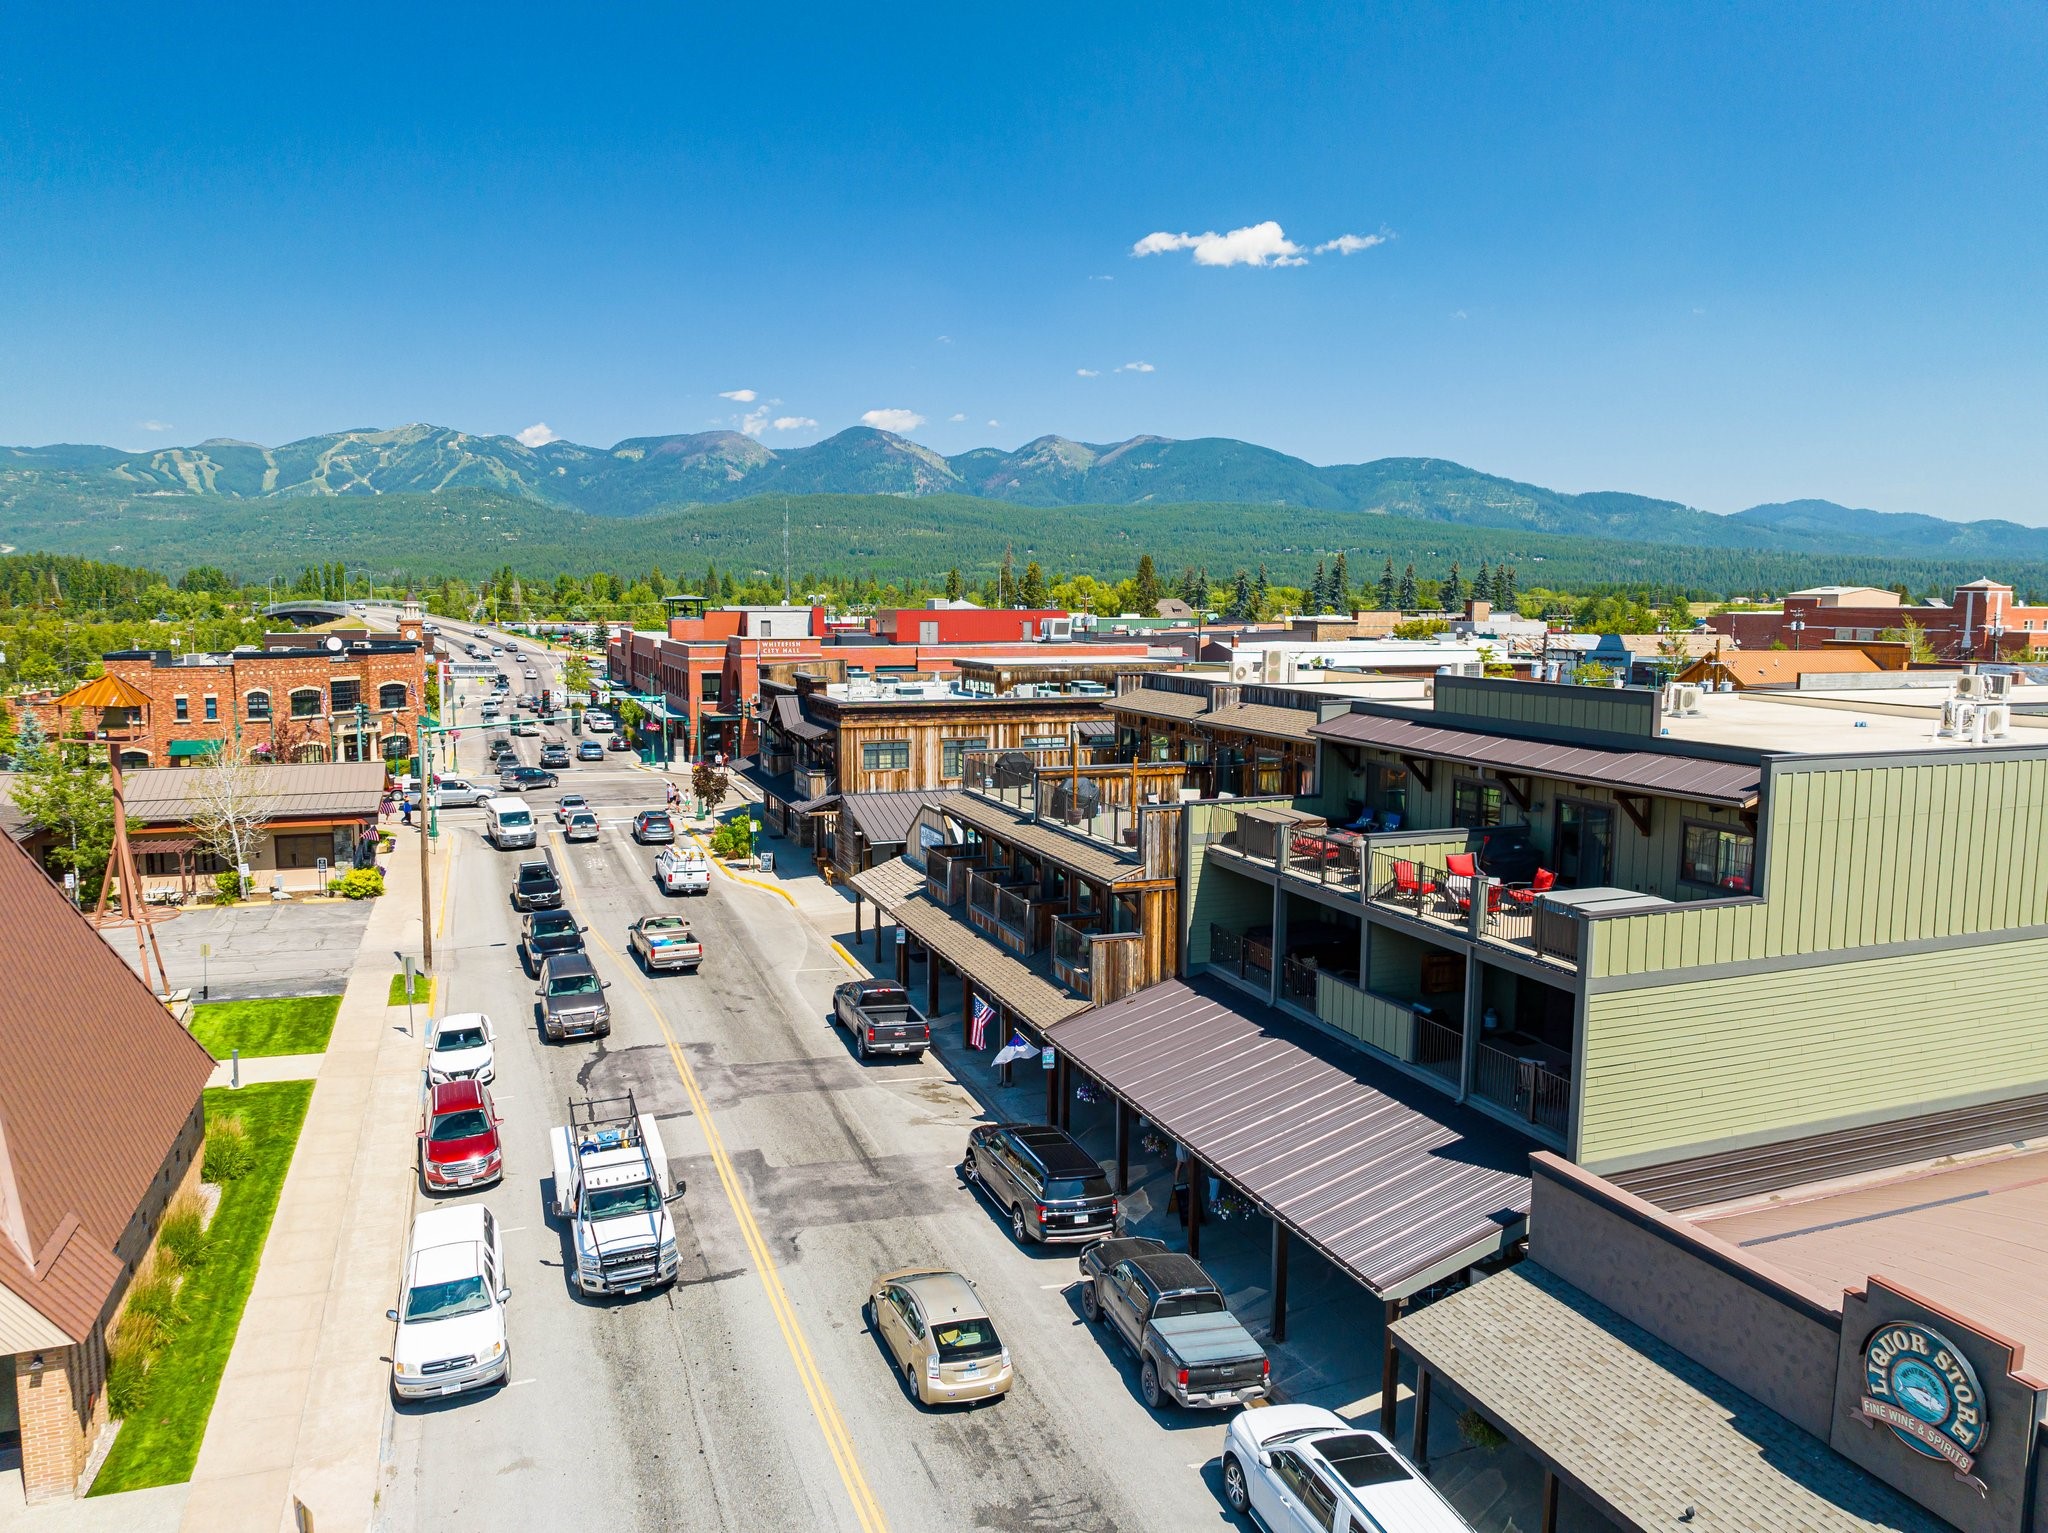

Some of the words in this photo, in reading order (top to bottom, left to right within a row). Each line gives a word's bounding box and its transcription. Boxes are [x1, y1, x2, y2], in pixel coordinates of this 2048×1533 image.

[1868, 1330, 1930, 1397] LIQUOR
[1933, 1349, 1979, 1446] STORE
[1863, 1400, 1886, 1418] FINE
[1888, 1408, 1916, 1428] WINE
[1917, 1424, 1925, 1436] &
[1927, 1430, 1969, 1470] SPIRITS
